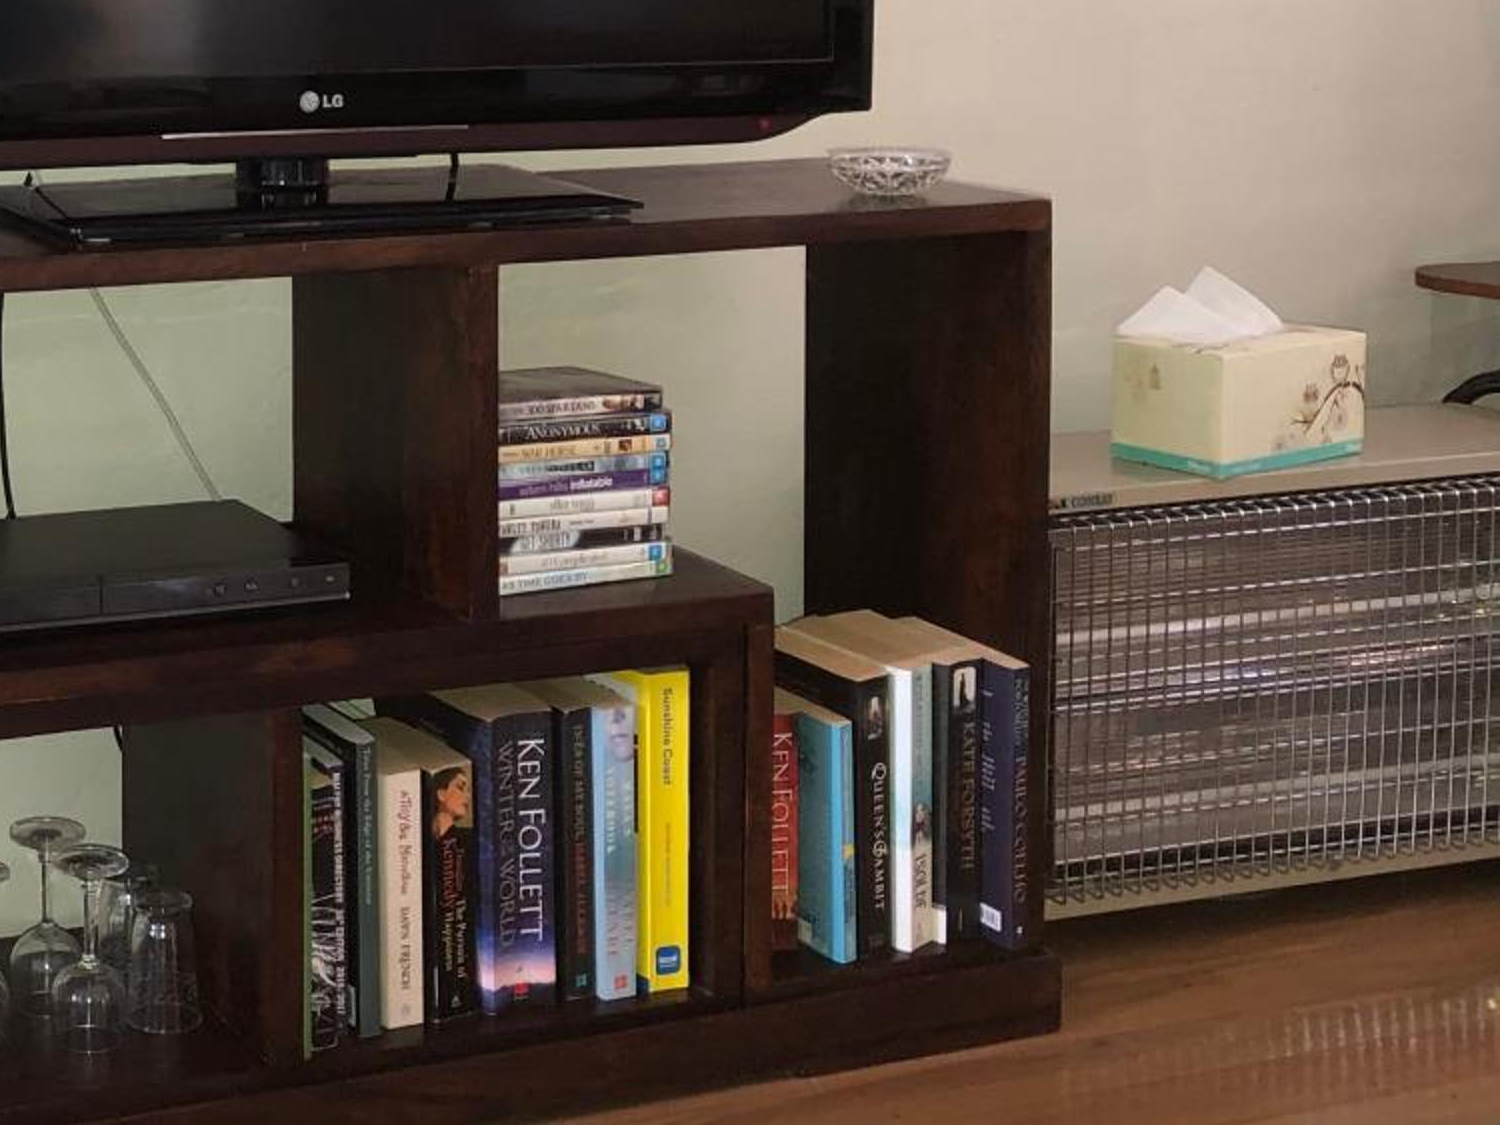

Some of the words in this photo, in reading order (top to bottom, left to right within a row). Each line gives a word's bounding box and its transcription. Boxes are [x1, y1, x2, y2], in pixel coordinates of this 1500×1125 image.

[322, 94, 344, 108] LG
[662, 687, 674, 746] Sunshine
[962, 722, 977, 772] KATE
[518, 738, 546, 800] KEN
[662, 749, 674, 786] Coast
[772, 731, 793, 781] KEN
[498, 740, 516, 840] WINTER
[961, 779, 976, 871] FORSYTH
[442, 838, 457, 908] Kennedy
[518, 808, 547, 942] FOLLETT
[1013, 823, 1028, 904] COELHO
[498, 857, 516, 947] WORLD
